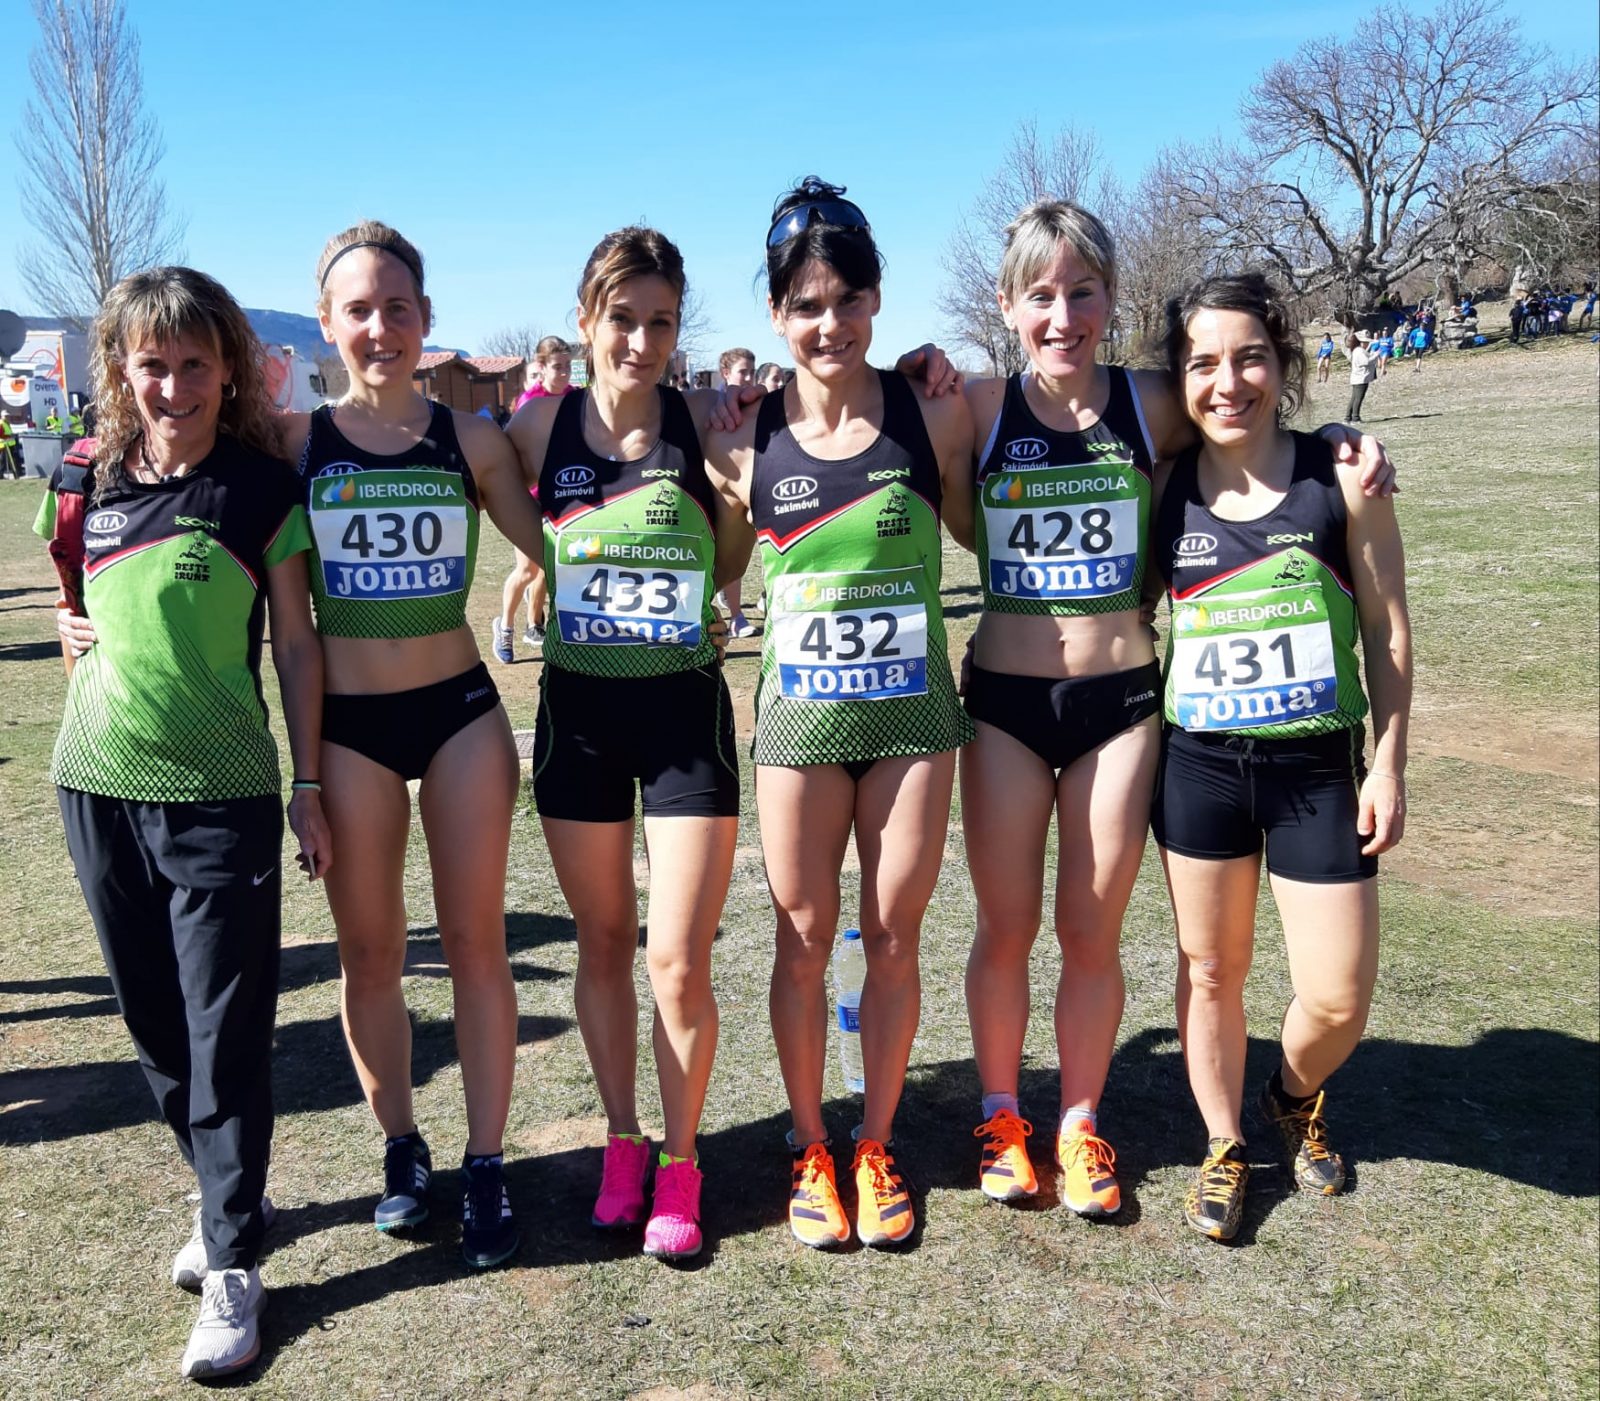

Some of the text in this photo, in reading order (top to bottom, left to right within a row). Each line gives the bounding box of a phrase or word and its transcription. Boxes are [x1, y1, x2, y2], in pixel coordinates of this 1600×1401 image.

[1011, 445, 1041, 456] KIA
[561, 471, 587, 482] KIA
[1026, 476, 1129, 498] IBERDROLA
[359, 483, 457, 498] IBERDROLA
[779, 481, 810, 497] KIA
[93, 516, 120, 530] KIA
[1008, 508, 1113, 557] 428
[341, 511, 443, 558] 430
[604, 544, 698, 561] IBERDROLA
[1179, 540, 1209, 552] KIA
[581, 568, 679, 616] 433
[820, 580, 916, 601] IBERDROLA
[1210, 599, 1317, 626] IBERDROLA
[799, 612, 901, 661] 432
[1195, 633, 1296, 686] 431
